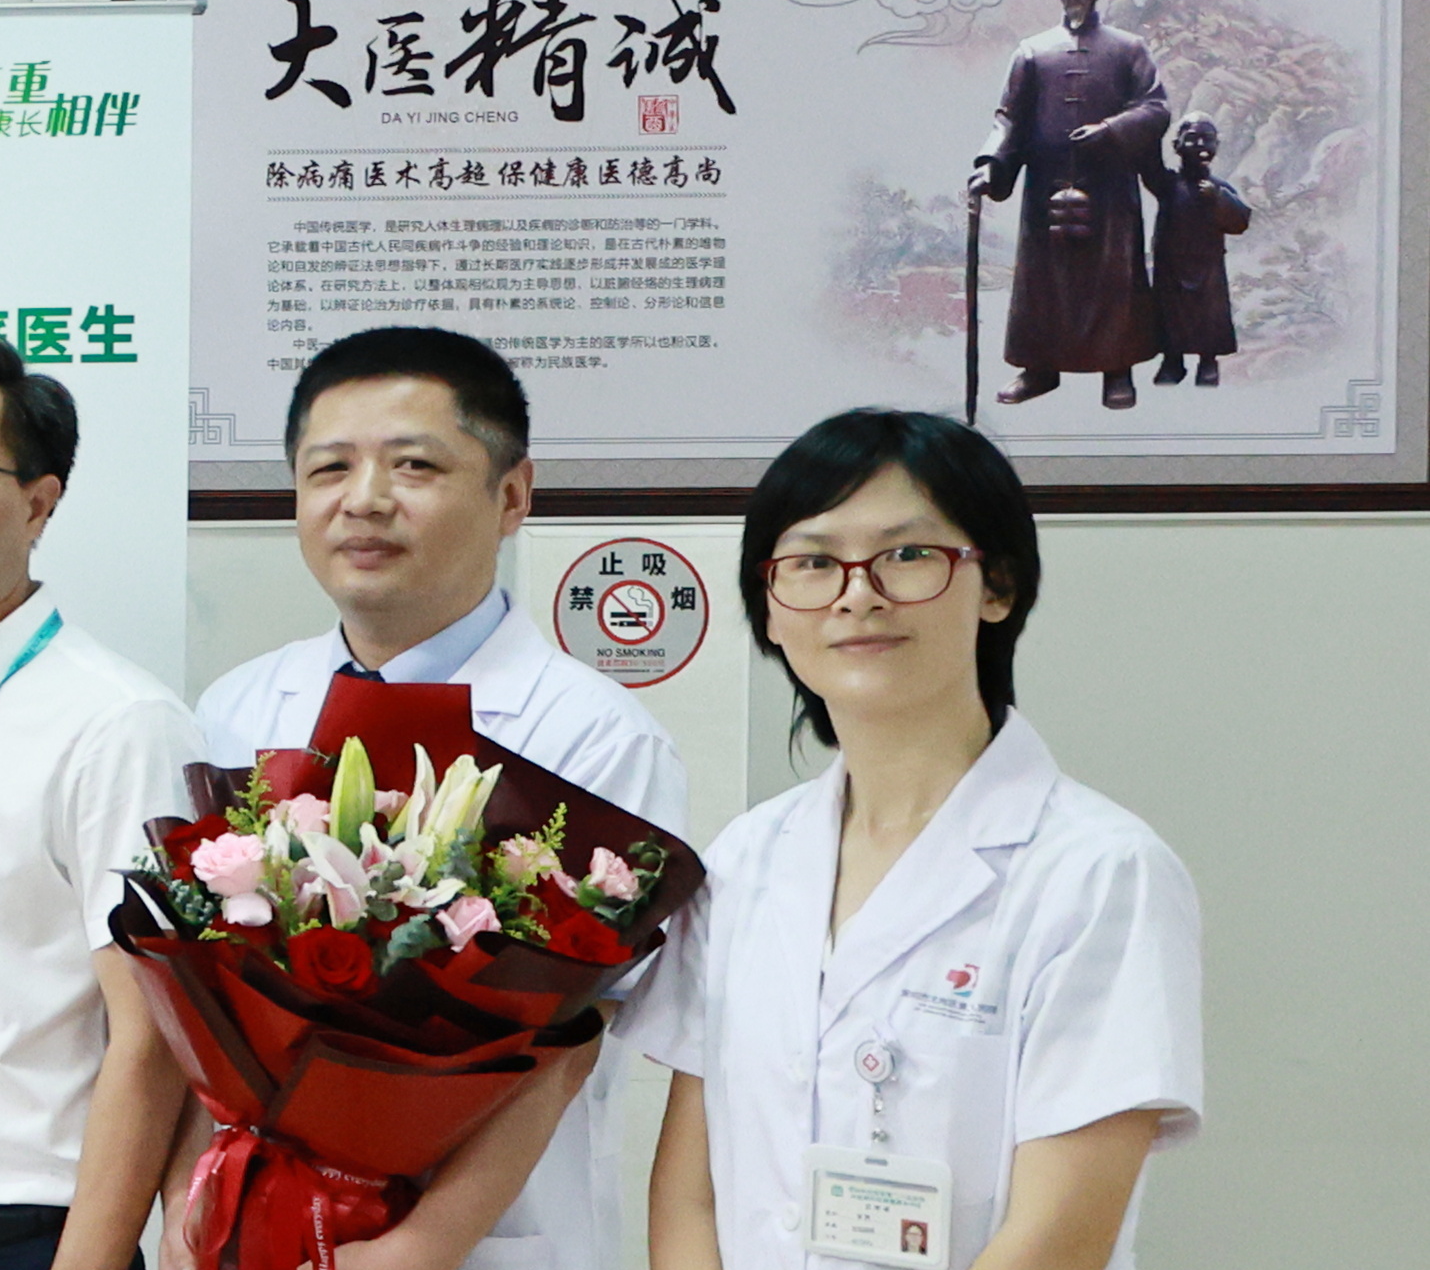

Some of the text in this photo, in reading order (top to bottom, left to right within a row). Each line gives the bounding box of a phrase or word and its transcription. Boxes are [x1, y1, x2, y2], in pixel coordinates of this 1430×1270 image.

[381, 111, 519, 124] DA YI JING CHENG
[596, 648, 666, 658] NO SMOKING
